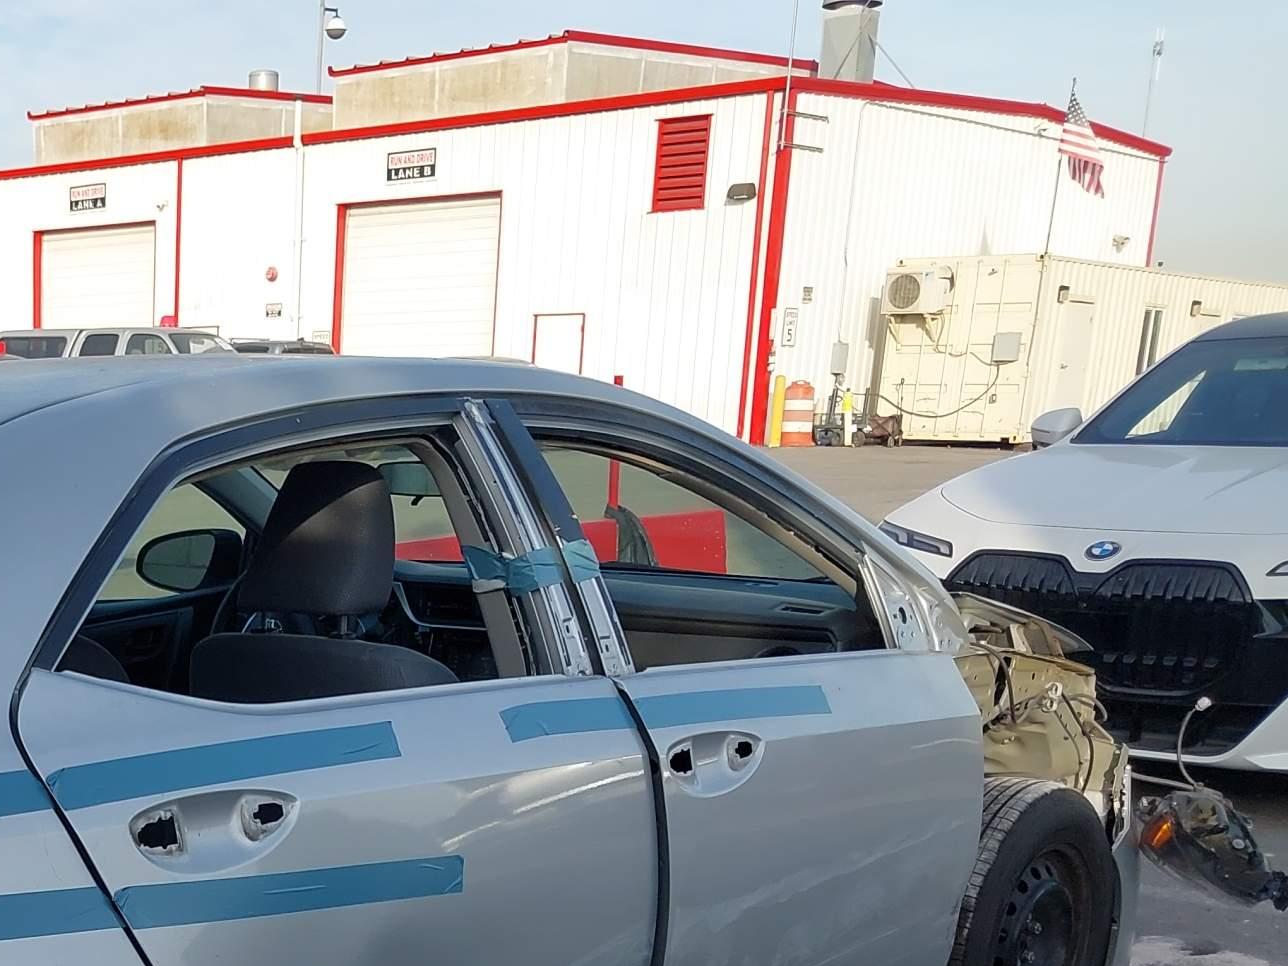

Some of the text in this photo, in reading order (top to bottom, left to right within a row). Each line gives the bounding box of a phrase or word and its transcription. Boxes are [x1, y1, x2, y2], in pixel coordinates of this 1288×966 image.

[390, 151, 433, 166] RUN AND DRIVE
[391, 166, 432, 180] LANE B
[72, 198, 103, 211] LANE A
[786, 328, 793, 342] 5
